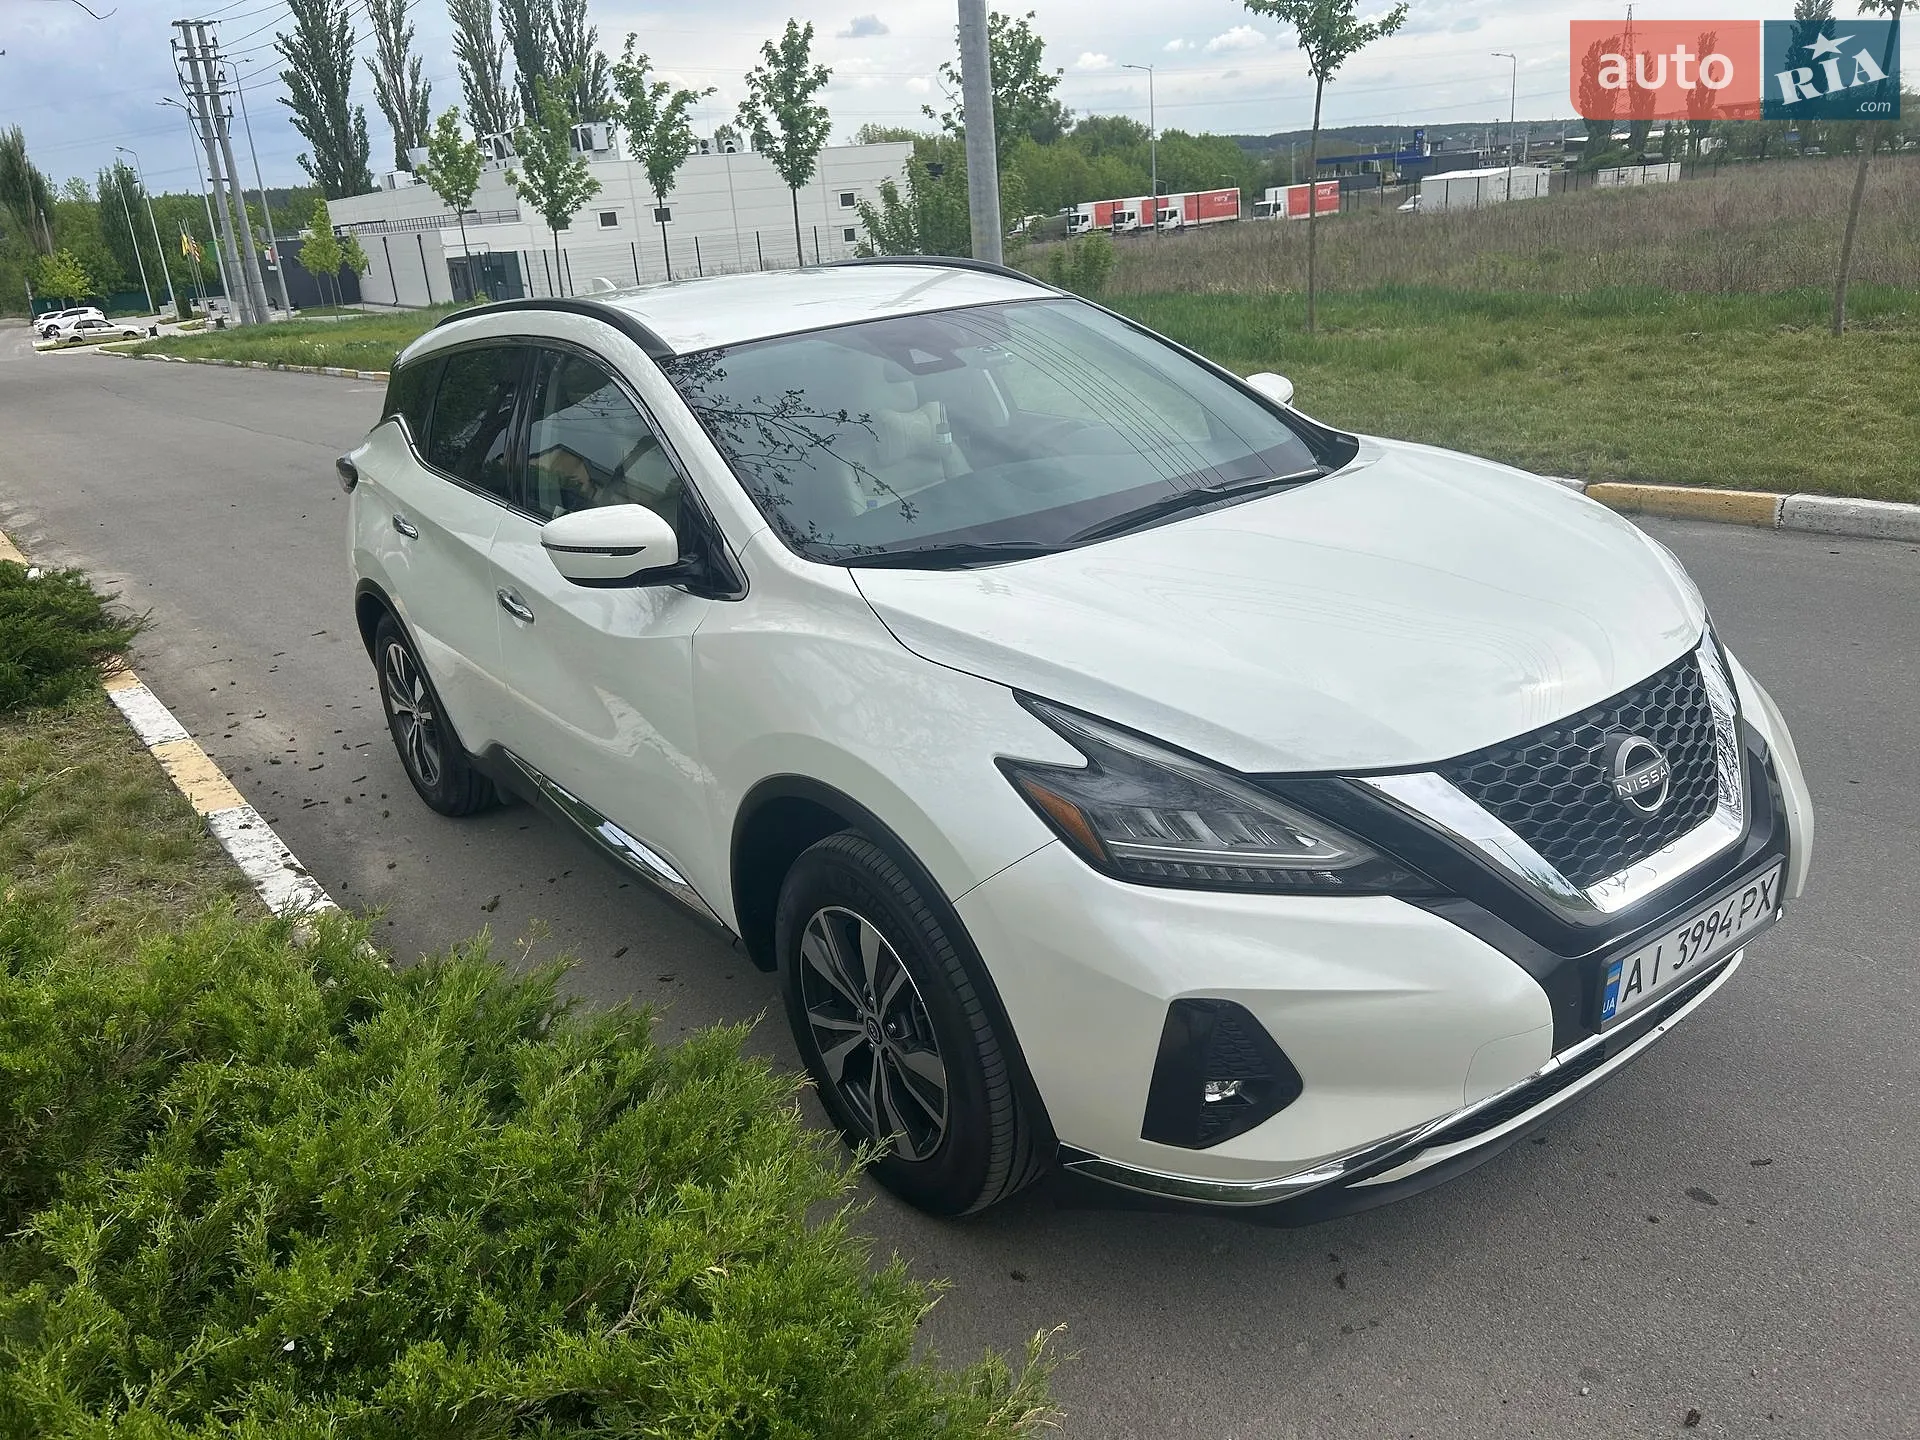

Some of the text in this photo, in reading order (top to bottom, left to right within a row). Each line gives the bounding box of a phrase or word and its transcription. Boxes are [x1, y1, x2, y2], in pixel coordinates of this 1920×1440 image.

[1616, 761, 1671, 796] NISSAN
[1621, 871, 1777, 1003] AI 3994 PX
[1602, 996, 1616, 1014] UA
